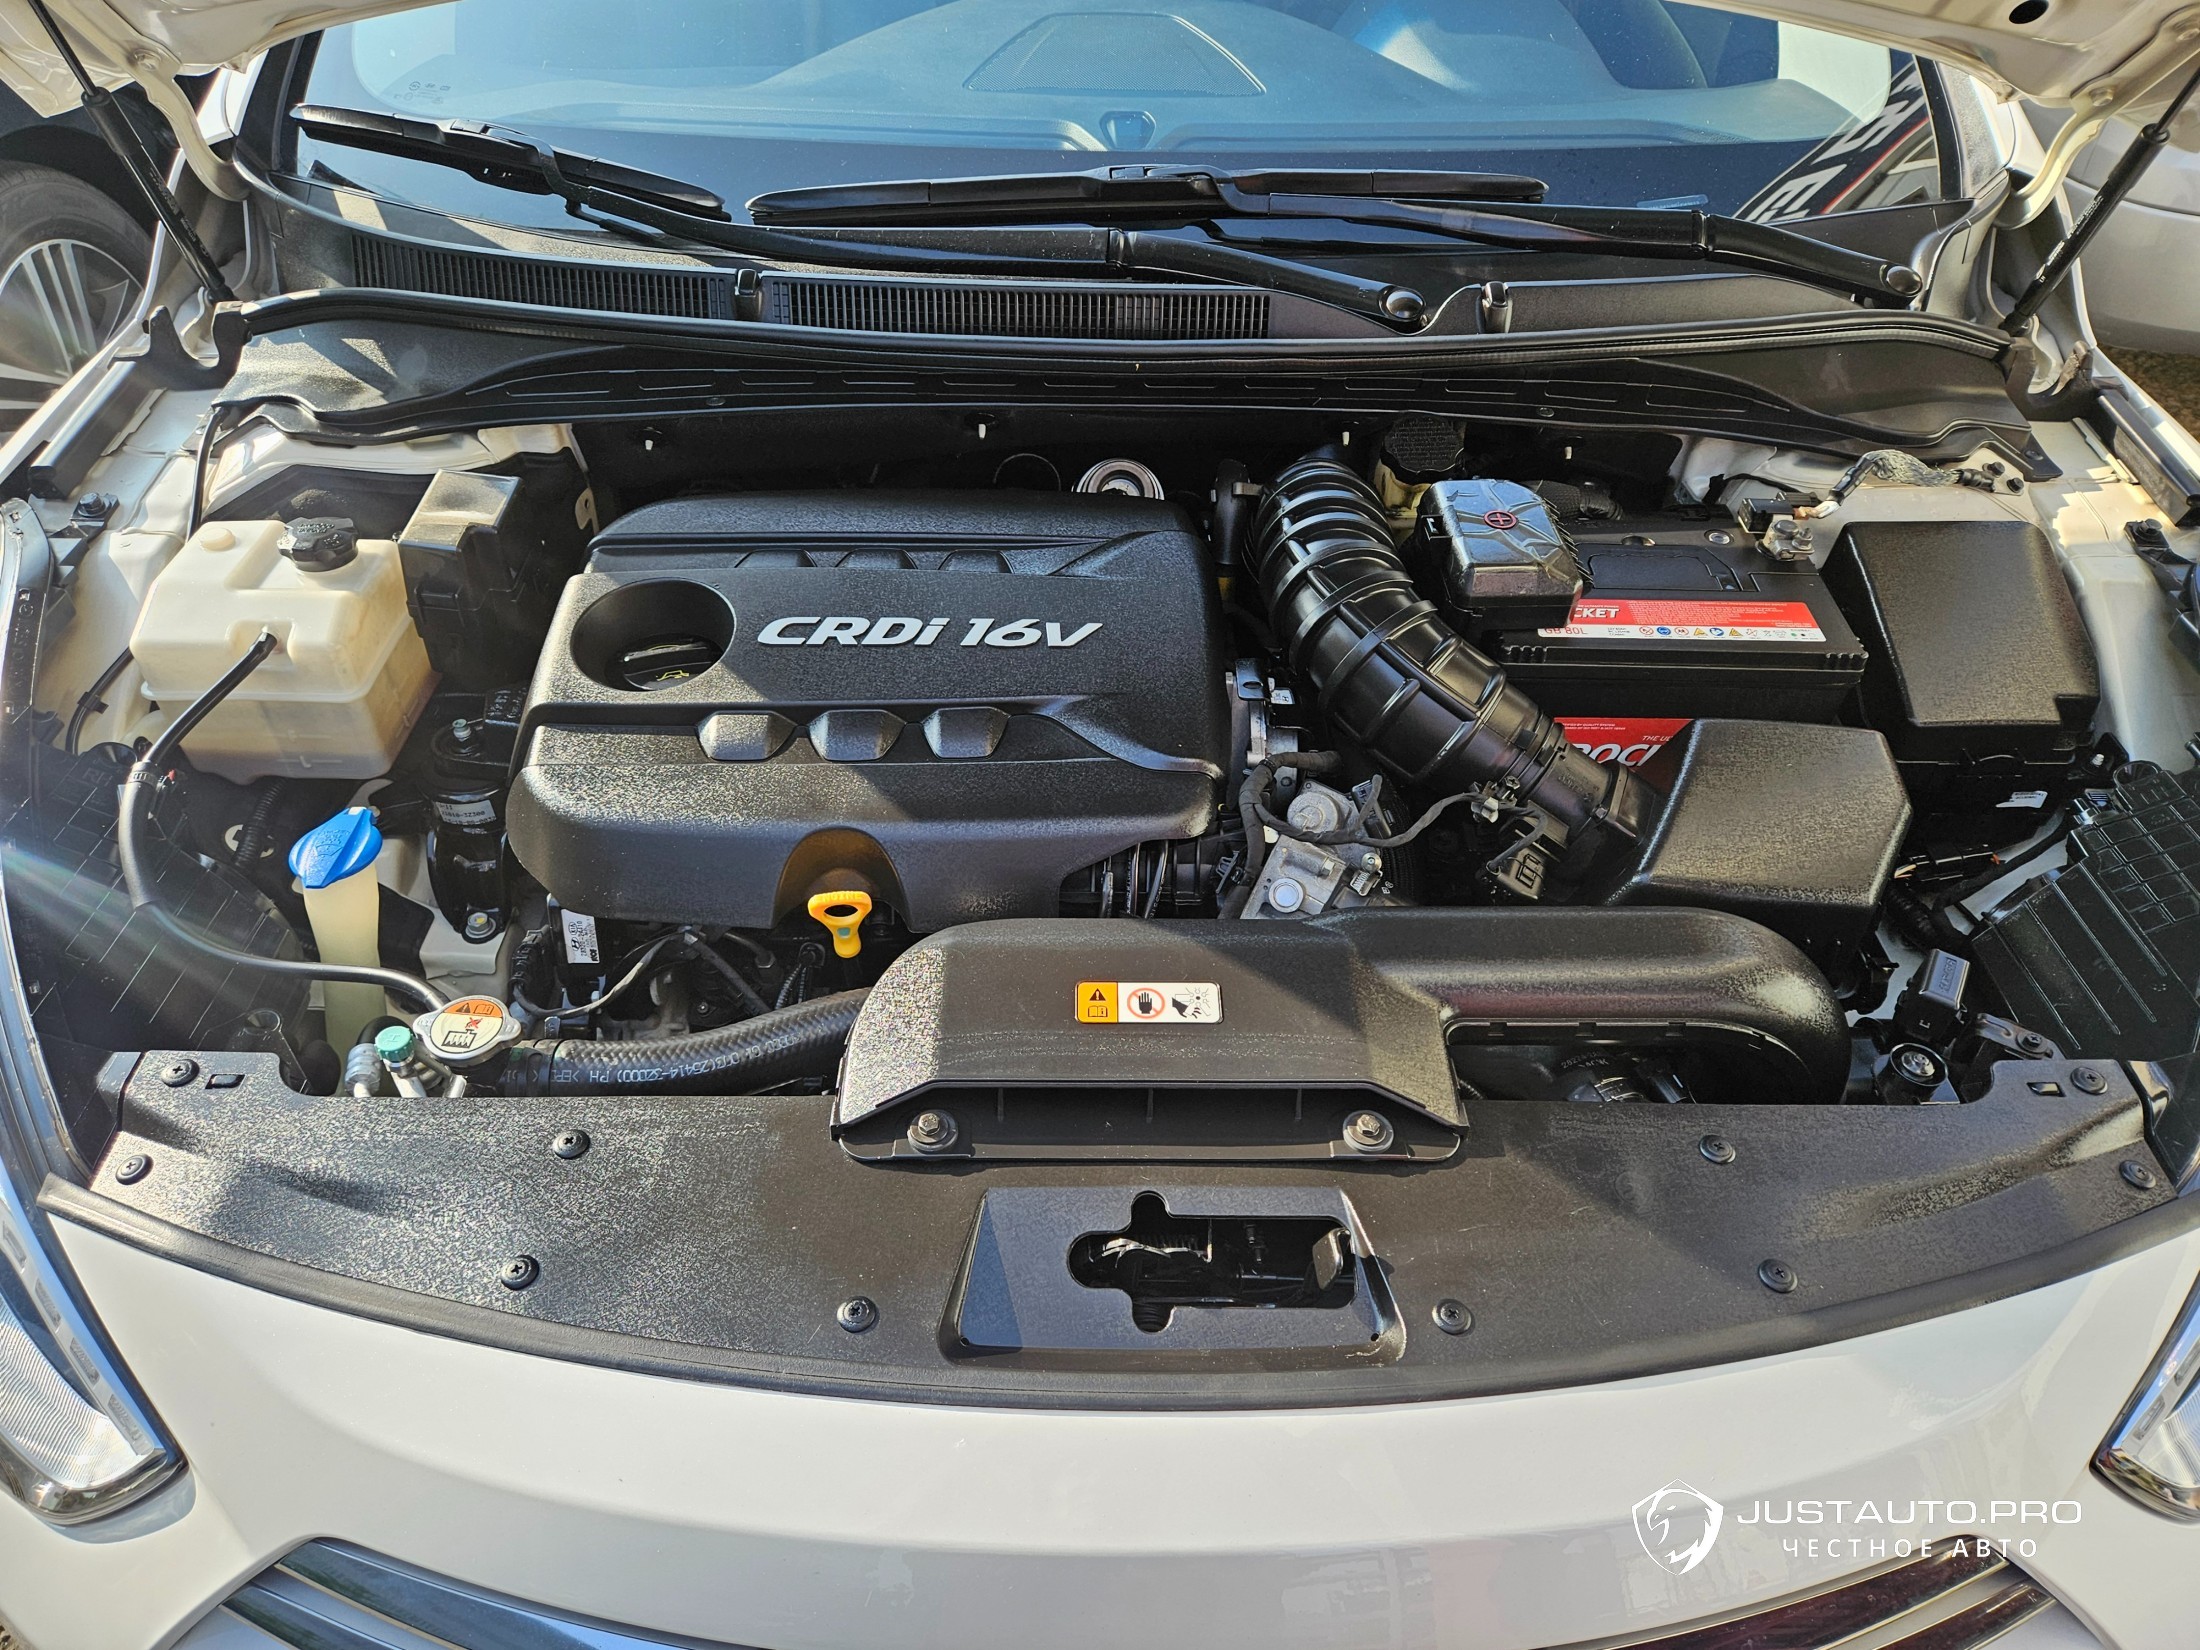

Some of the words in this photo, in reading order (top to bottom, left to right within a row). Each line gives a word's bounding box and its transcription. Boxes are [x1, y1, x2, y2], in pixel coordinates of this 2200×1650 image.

[757, 616, 950, 646] CRDi
[959, 618, 1104, 648] 16V
[1564, 627, 1588, 635] 80L
